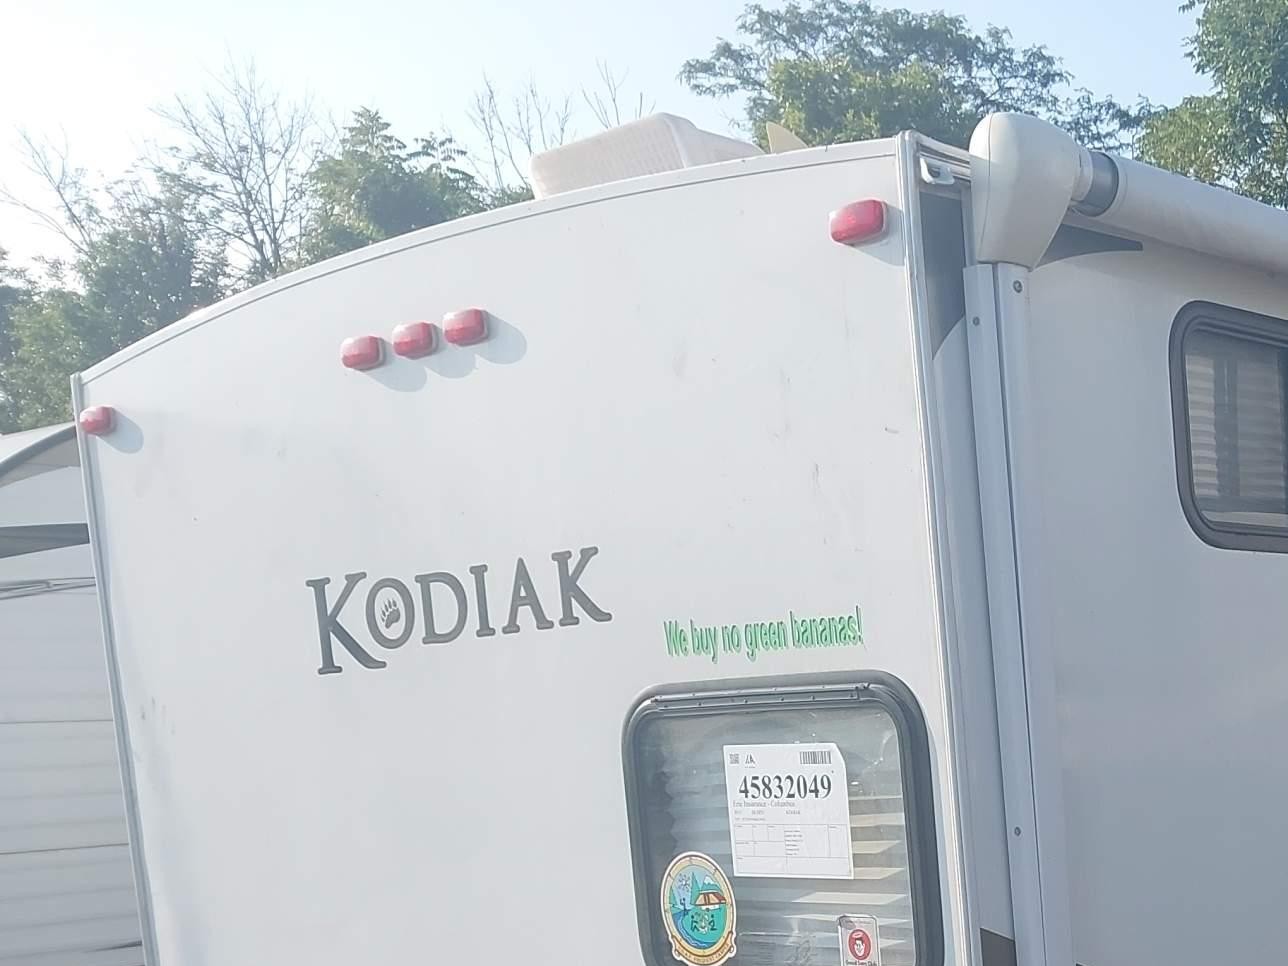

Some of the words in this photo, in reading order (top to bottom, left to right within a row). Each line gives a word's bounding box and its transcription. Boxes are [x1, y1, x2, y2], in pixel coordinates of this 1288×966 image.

[306, 546, 612, 675] KODIAK
[664, 620, 688, 656] We
[690, 619, 717, 663] buy
[722, 624, 741, 653] no
[744, 620, 789, 661] green
[789, 605, 864, 648] bananas!
[739, 774, 831, 799] 45832049
